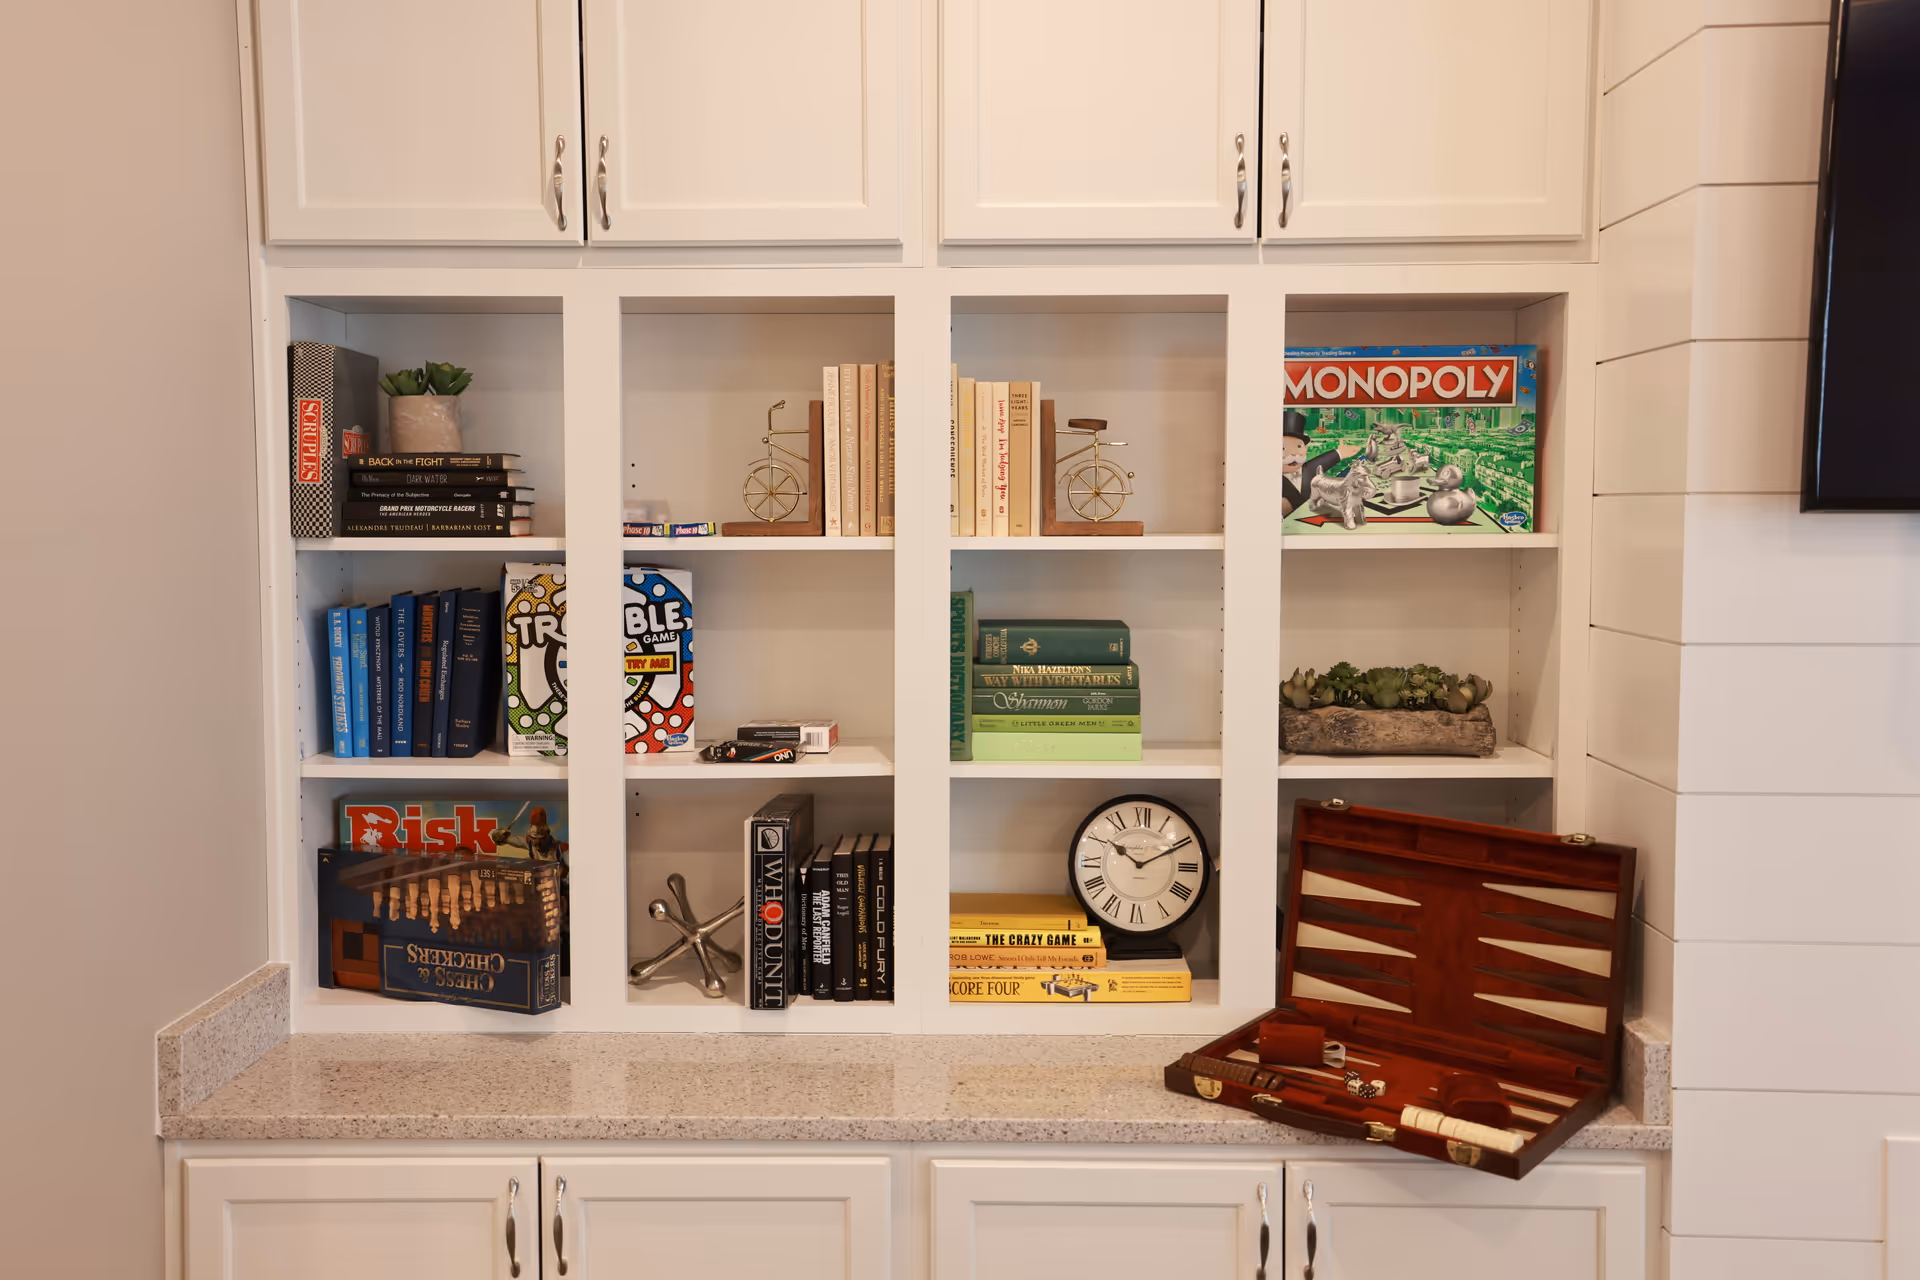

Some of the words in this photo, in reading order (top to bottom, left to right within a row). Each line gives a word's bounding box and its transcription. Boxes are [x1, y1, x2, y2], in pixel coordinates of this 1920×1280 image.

[1284, 364, 1510, 400] MONOPOLY
[301, 402, 319, 480] SCRUPLES
[368, 458, 394, 466] BACK
[415, 458, 444, 466] FIGHT
[997, 452, 1008, 481] Judging
[406, 474, 423, 484] DARK
[424, 474, 448, 484] WATER
[643, 526, 651, 535] 10
[676, 525, 692, 535] Phase
[421, 604, 434, 643] MONSTERS
[950, 597, 965, 653] SPORTS
[397, 627, 405, 657] LOVERS
[643, 632, 676, 643] GAME
[441, 640, 449, 669] Regulated
[626, 659, 647, 669] TRY
[650, 658, 671, 669] ME!
[983, 676, 1009, 687] WAY
[1011, 676, 1043, 687] WITH
[1047, 675, 1121, 686] VEGETABLES
[1012, 664, 1035, 674] NIKA
[1037, 664, 1092, 674] HAZELTON'S
[439, 670, 447, 700] Exchanges
[633, 681, 650, 701] BUBBLE
[950, 656, 965, 743] DICTIONARY
[993, 692, 1069, 711] Shannon
[334, 694, 348, 733] STRIKES
[773, 750, 794, 762] UNO
[345, 804, 498, 854] Risk
[1134, 807, 1152, 828] XII
[480, 869, 491, 878] SET
[857, 864, 866, 894] UNLIKELY
[1178, 861, 1198, 873] III
[812, 892, 822, 905] THE
[821, 890, 831, 918] ADAM
[877, 885, 885, 933] COLD
[812, 907, 822, 925] LAST
[857, 895, 867, 933] COMPANIONS
[801, 927, 807, 936] of
[821, 920, 831, 965] CANFIELD
[985, 934, 1005, 946] THE
[1008, 934, 1043, 946] CRAZY
[1047, 934, 1077, 946] GAME
[812, 926, 822, 963] REPORTER
[406, 943, 505, 974] CHECKERS
[877, 937, 885, 984] FURY
[417, 967, 430, 983] &
[435, 966, 495, 993] CHESS
[987, 981, 1020, 995] FOUR
